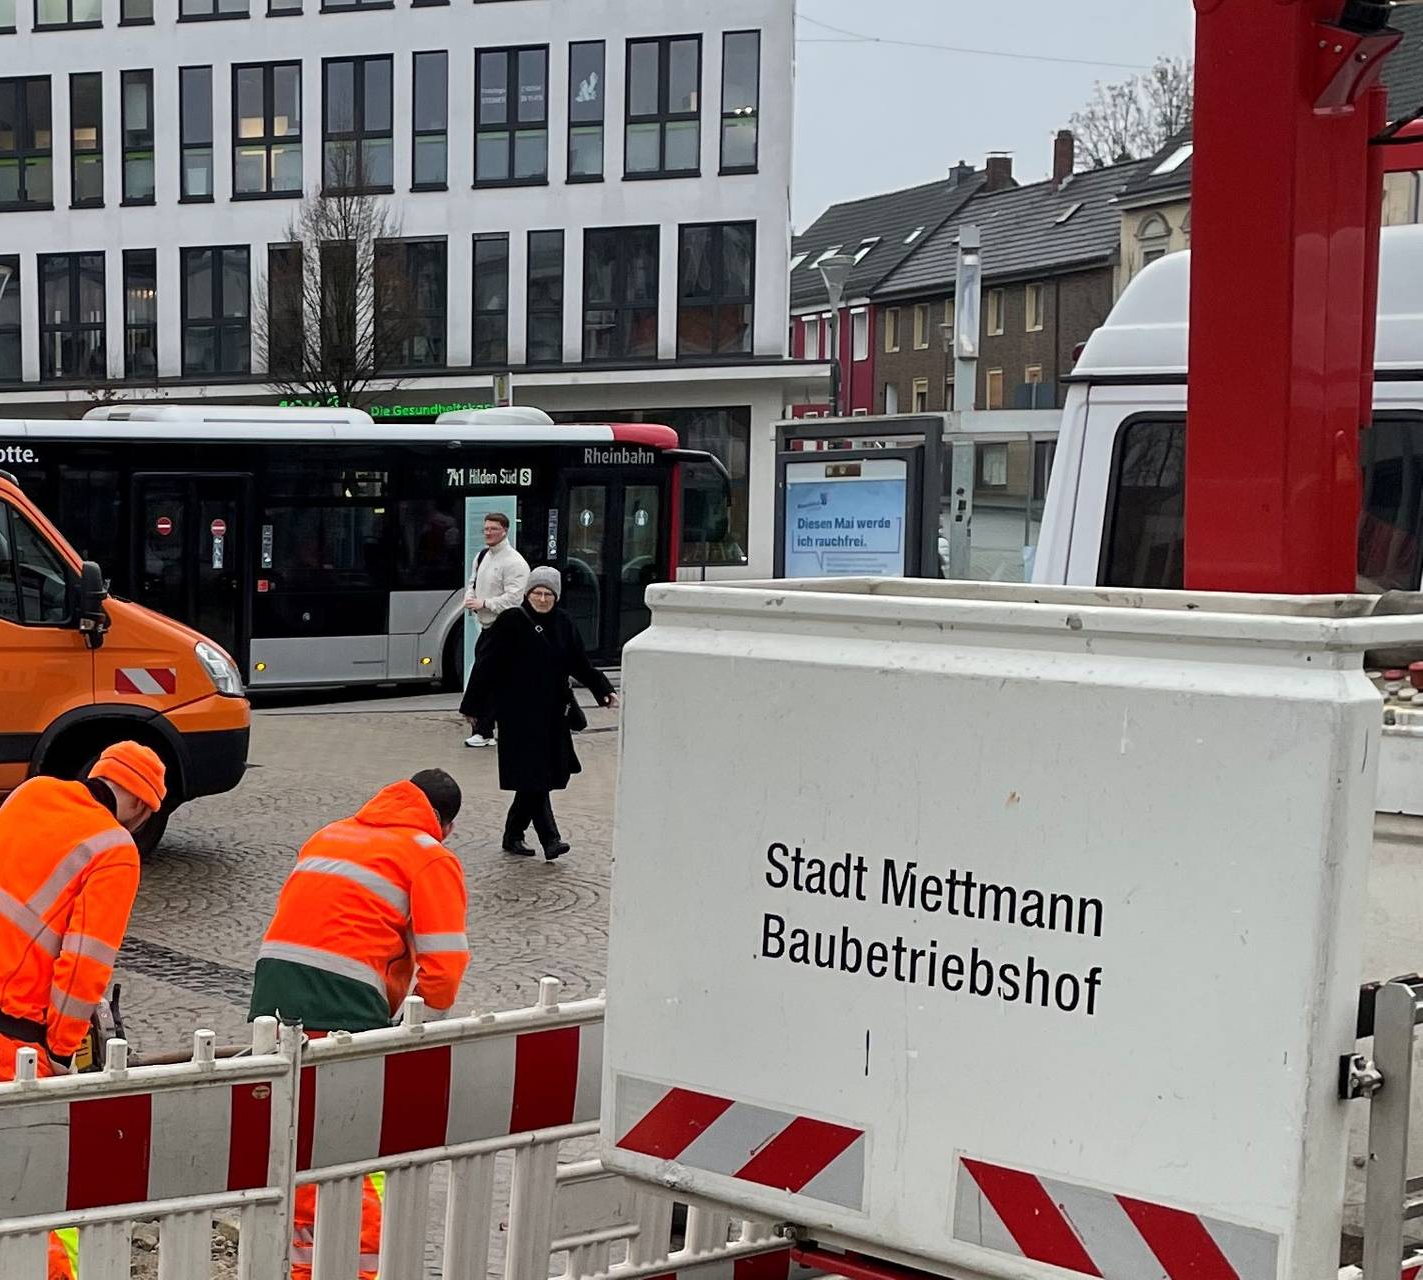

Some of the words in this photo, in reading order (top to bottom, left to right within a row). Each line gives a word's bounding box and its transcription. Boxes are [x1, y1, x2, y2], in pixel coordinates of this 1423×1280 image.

[371, 405, 391, 417] Die
[584, 448, 655, 465] Rheinbahn
[447, 468, 465, 486] 741
[469, 468, 497, 484] Hilden
[499, 468, 517, 484] Süd
[797, 517, 832, 530] Diesen
[834, 516, 854, 529] Mai
[857, 516, 891, 529] werde
[797, 535, 813, 547] ich
[815, 534, 867, 547] rauchfrei.
[765, 842, 869, 902] Stadt
[881, 858, 1104, 937] Mettmann
[761, 913, 1103, 1015] Baubetriebshof
